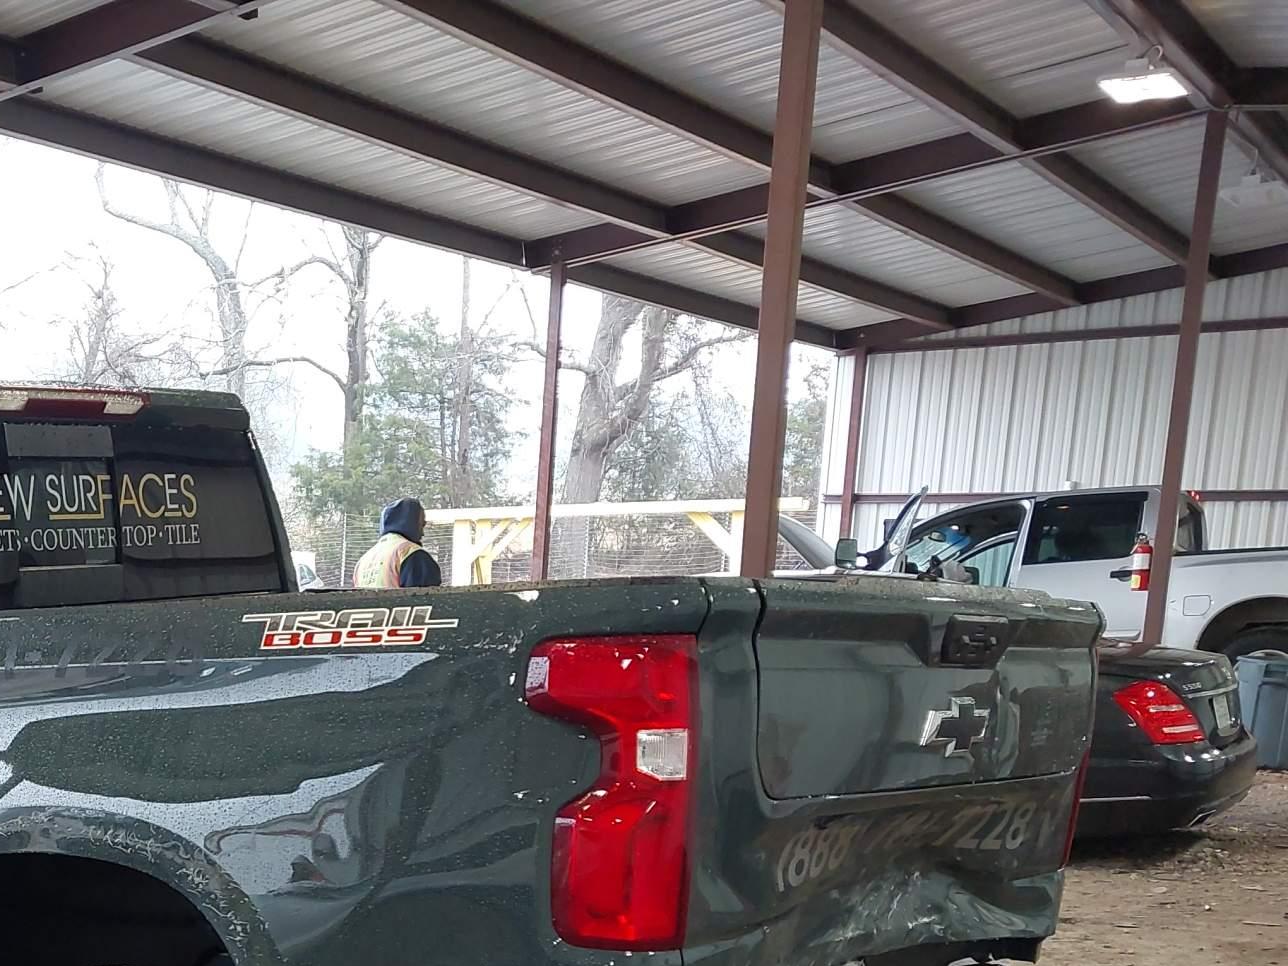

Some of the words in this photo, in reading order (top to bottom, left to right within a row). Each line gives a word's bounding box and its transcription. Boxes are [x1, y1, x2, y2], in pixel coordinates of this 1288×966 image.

[45, 473, 198, 520] SURFACES
[242, 605, 460, 632] TRAIL
[260, 627, 429, 649] BOSS
